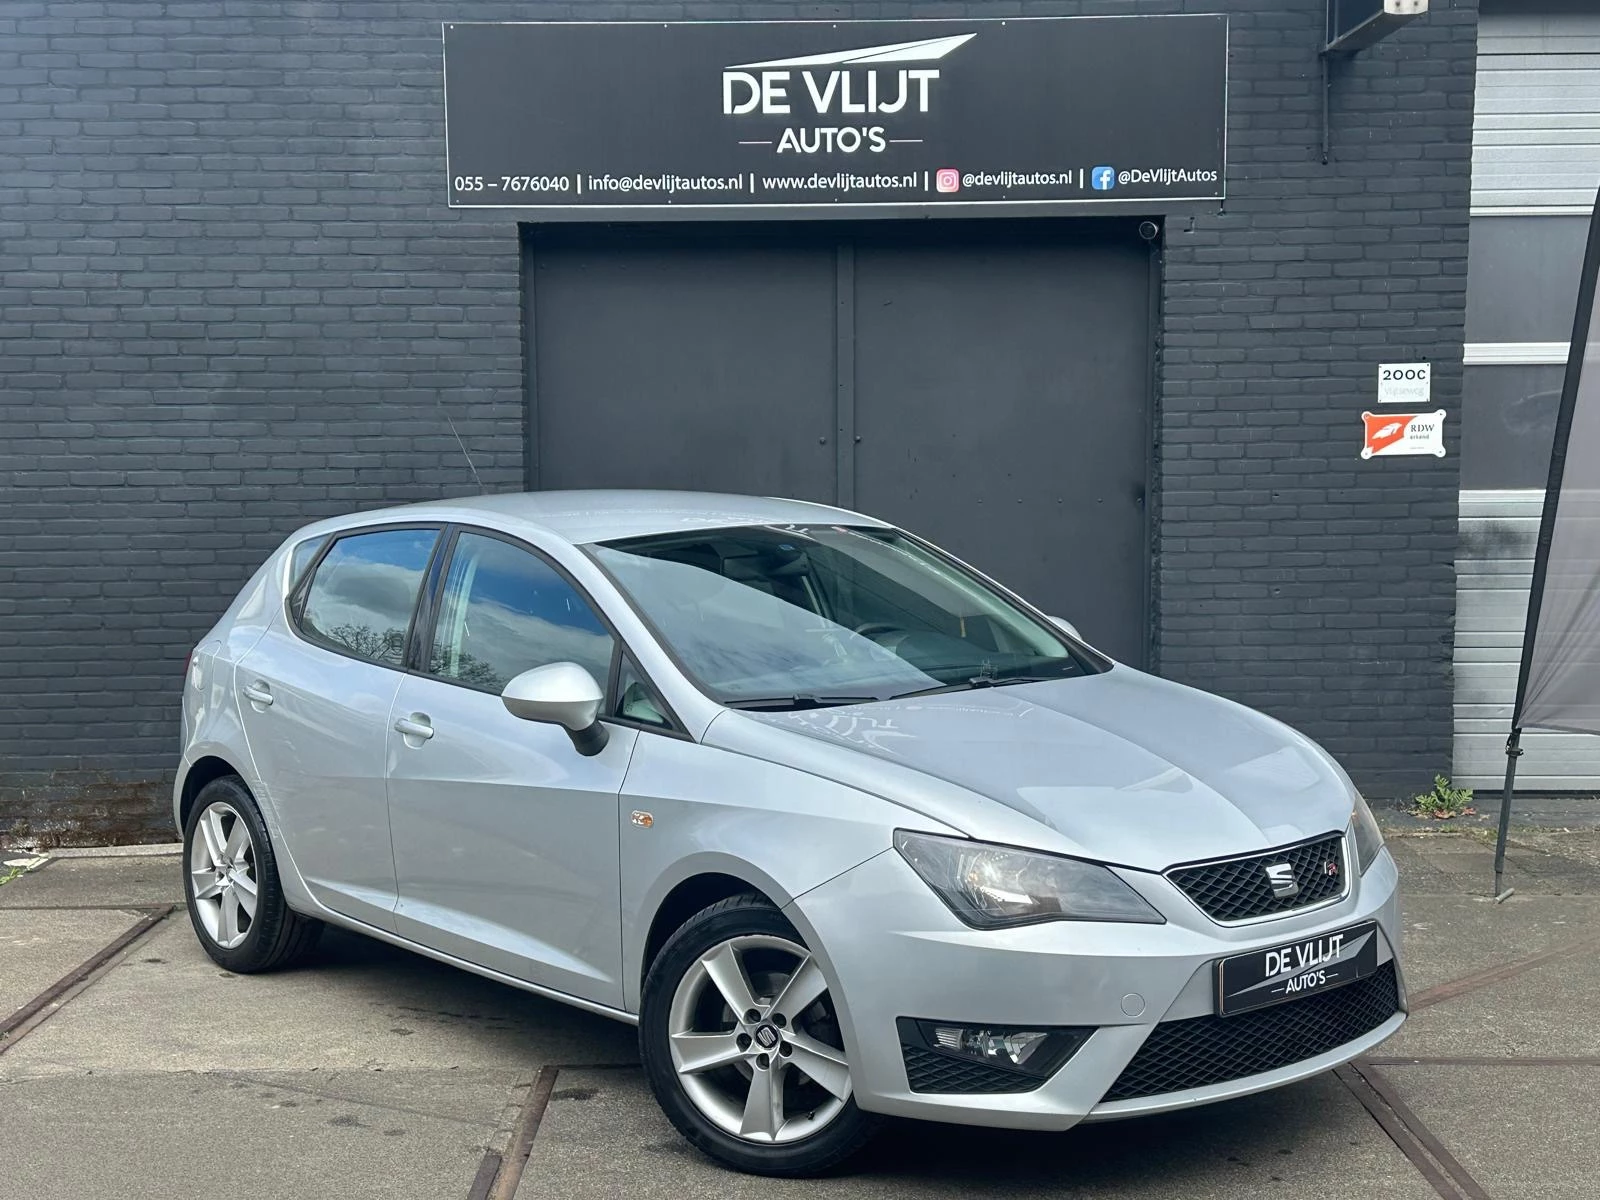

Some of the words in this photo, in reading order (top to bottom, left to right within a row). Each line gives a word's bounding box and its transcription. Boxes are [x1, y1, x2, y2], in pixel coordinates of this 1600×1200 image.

[723, 71, 790, 114] DE
[802, 69, 940, 114] VLIJT
[777, 126, 886, 153] AUTO'S
[454, 176, 483, 191] 055
[501, 176, 569, 191] 7676040
[588, 174, 743, 193] info@devlijtautos.nl
[762, 172, 917, 192] www.devlijtautos.nl
[962, 170, 1072, 188] @devlijtautos.nl
[1118, 168, 1218, 185] @DeVlijtAutos
[1410, 424, 1435, 432] RDW
[1265, 947, 1292, 977] DE
[1296, 934, 1344, 968] VLIJT
[1285, 970, 1326, 994] AUTO'S
